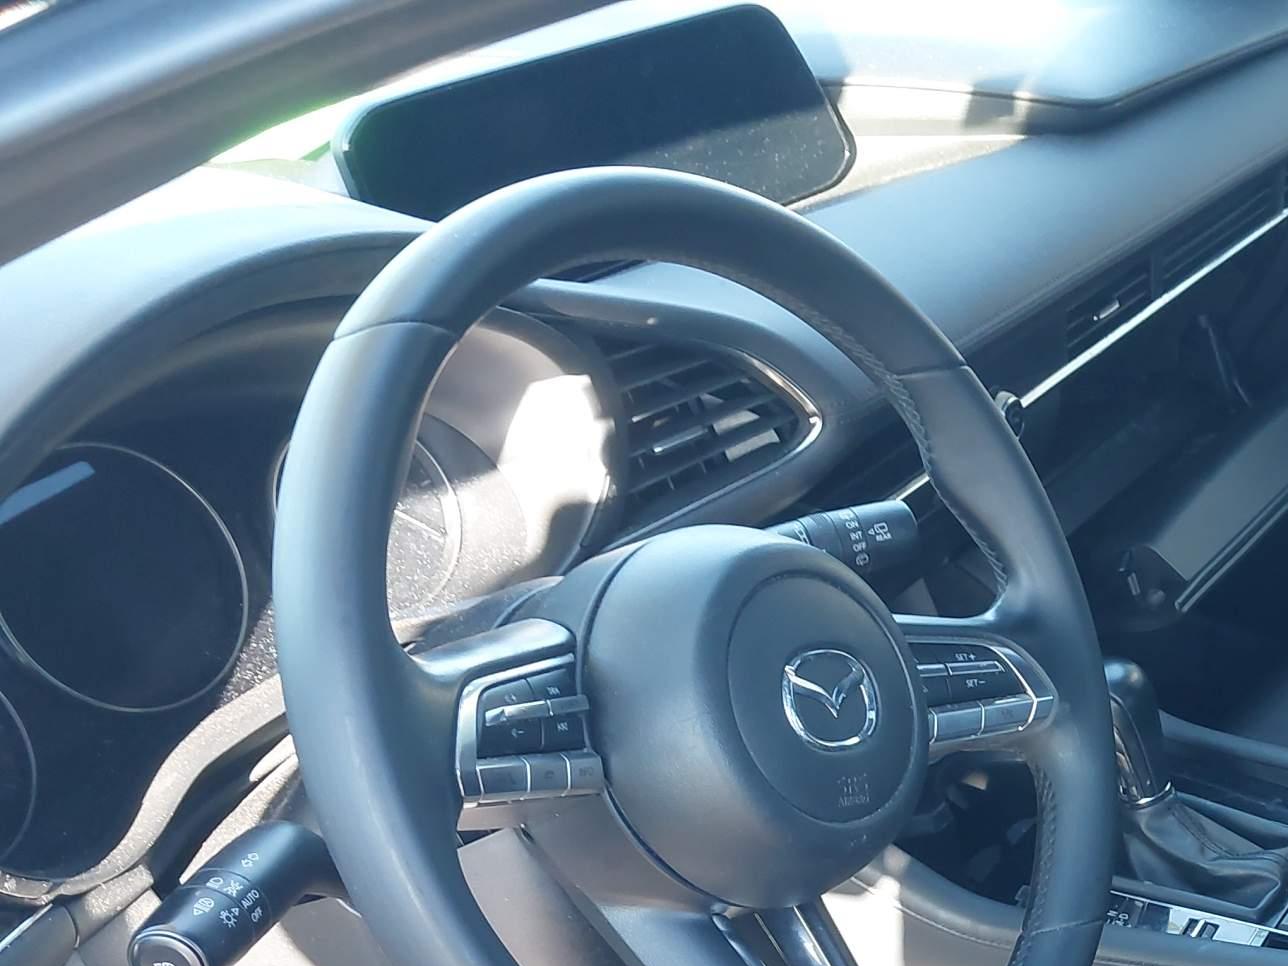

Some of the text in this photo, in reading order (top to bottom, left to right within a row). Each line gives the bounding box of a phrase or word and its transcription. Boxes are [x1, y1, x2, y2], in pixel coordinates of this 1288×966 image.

[846, 520, 859, 529] ON
[850, 530, 863, 541] INT
[853, 542, 866, 552] OFF
[241, 889, 259, 909] AUTO
[251, 907, 263, 922] OFF
